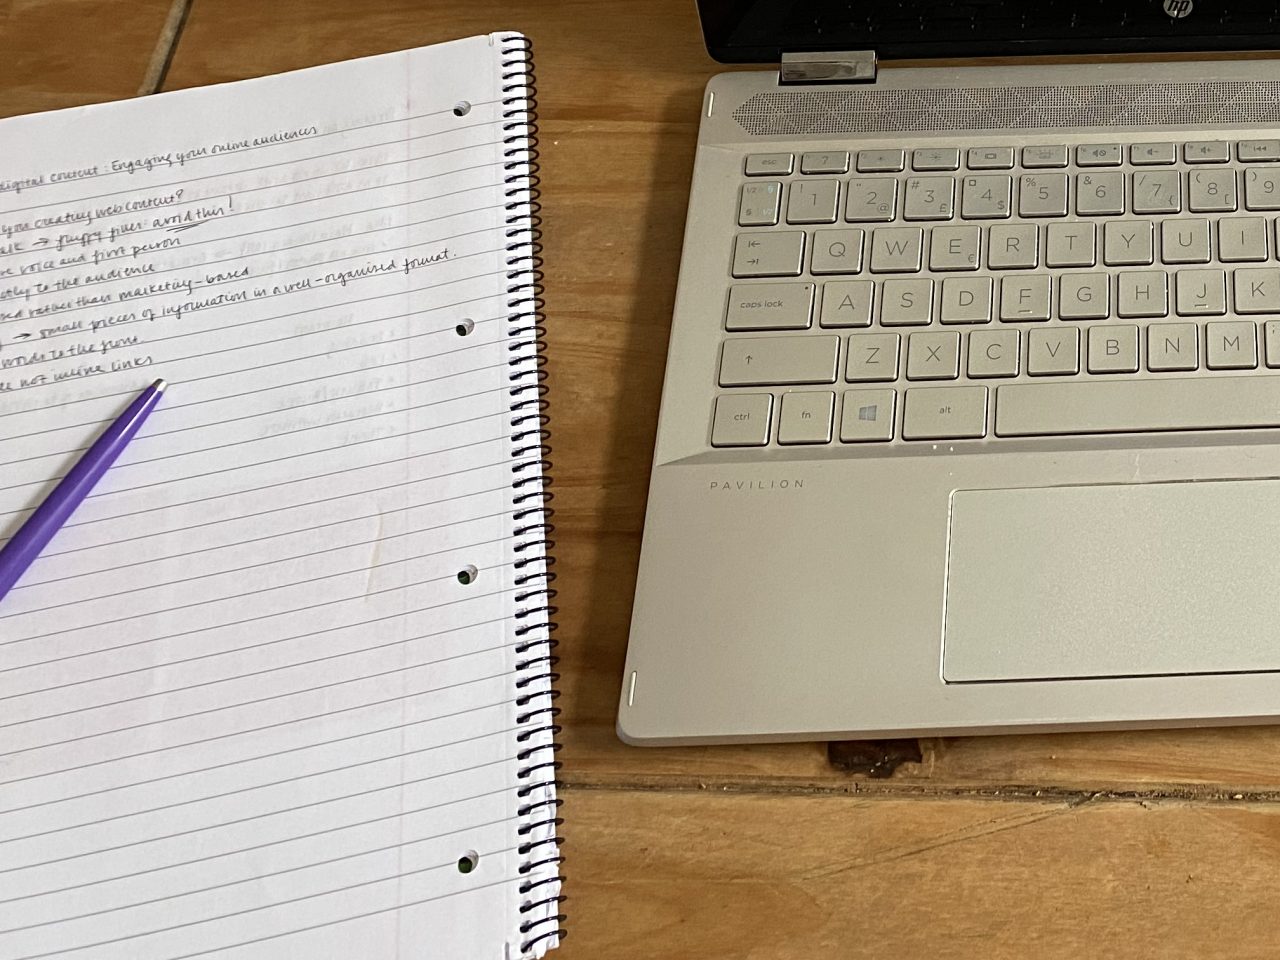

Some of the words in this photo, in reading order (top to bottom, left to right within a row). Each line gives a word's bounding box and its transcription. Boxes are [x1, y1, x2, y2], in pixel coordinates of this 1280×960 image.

[111, 153, 173, 174] Engaging
[211, 140, 250, 154] online
[252, 126, 318, 146] audiences
[60, 254, 86, 265] and
[92, 246, 126, 265] first
[132, 238, 180, 259] person
[828, 241, 846, 258] Q
[885, 240, 909, 256] W
[949, 239, 962, 254] E
[52, 277, 80, 291] the
[85, 263, 155, 284] audience
[142, 308, 156, 322] of
[162, 290, 247, 320] information
[254, 286, 267, 298] in
[740, 301, 762, 309] caps
[764, 299, 783, 308] lock
[66, 344, 96, 356] the
[734, 413, 750, 421] ctrl
[801, 411, 811, 419] fn
[939, 406, 952, 414] alt
[710, 480, 804, 490] PAVILION
